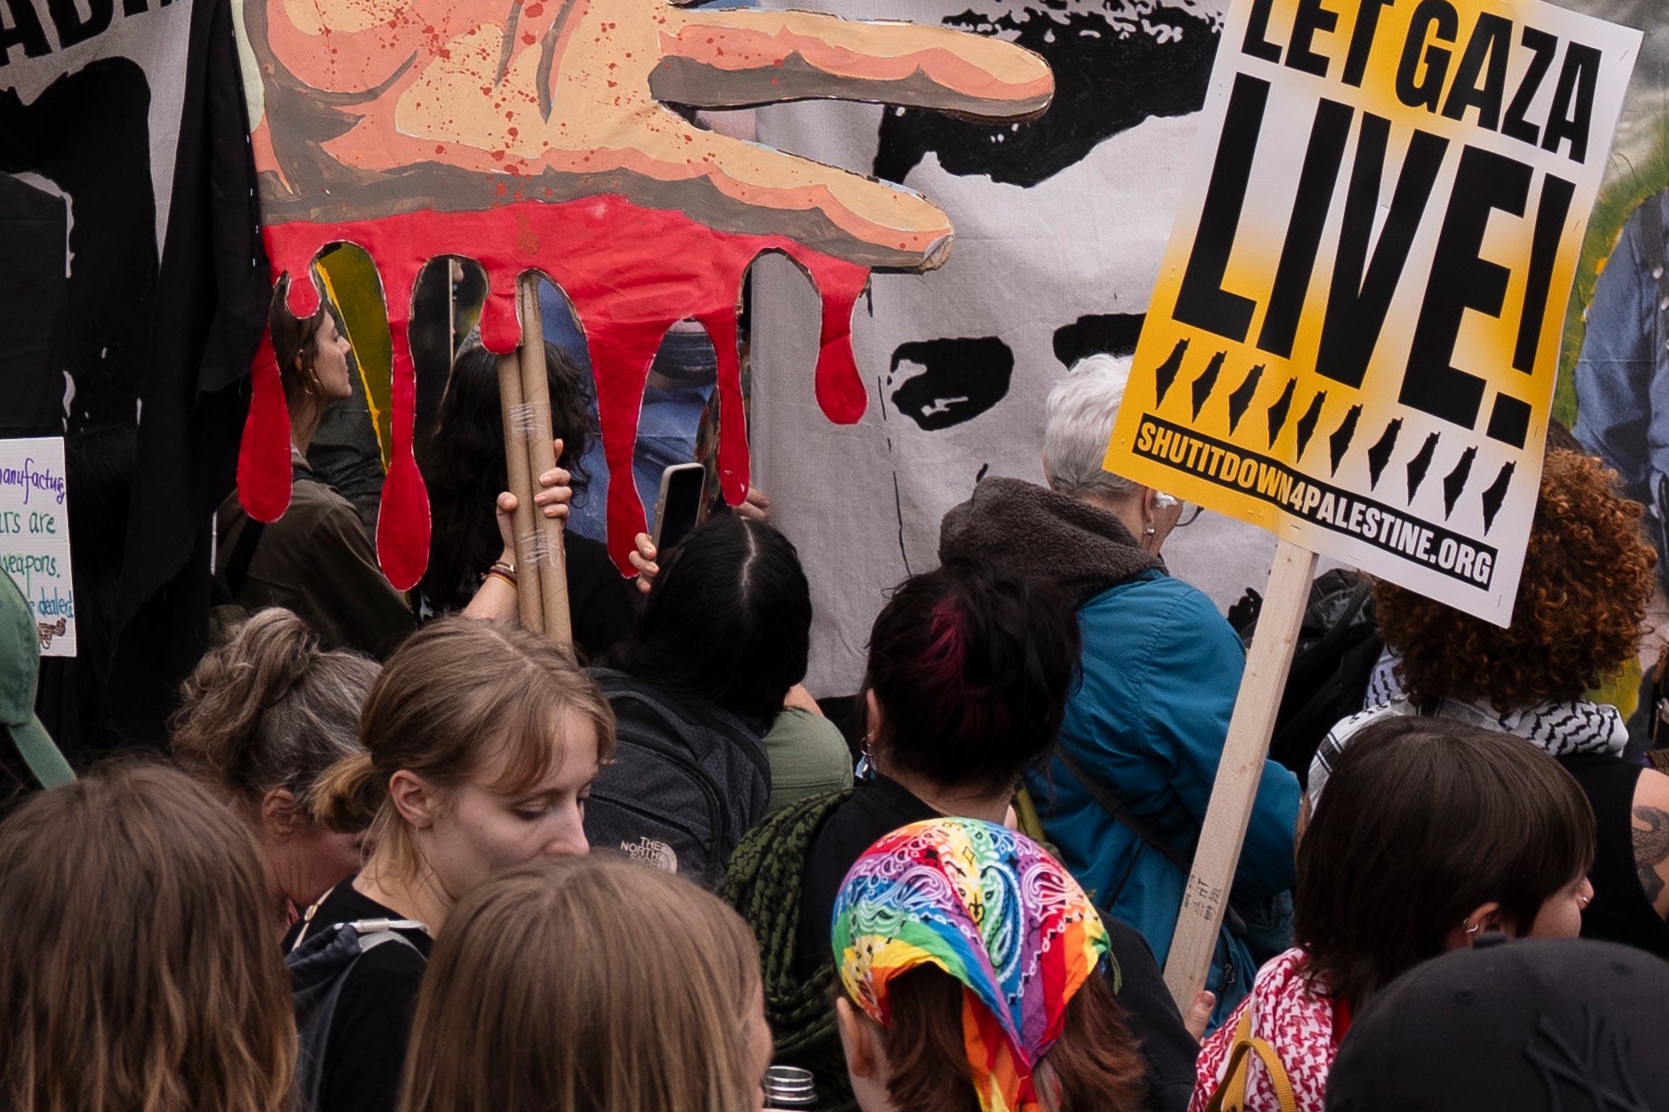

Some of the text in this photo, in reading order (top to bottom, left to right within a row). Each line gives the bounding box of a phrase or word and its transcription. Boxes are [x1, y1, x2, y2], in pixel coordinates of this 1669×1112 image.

[1171, 71, 1576, 450] LIVE!
[1136, 420, 1492, 585] SHUTITDOWN4PALESTINE.ORG
[29, 512, 57, 534] are
[620, 840, 659, 860] NORTH
[640, 836, 662, 851] THE
